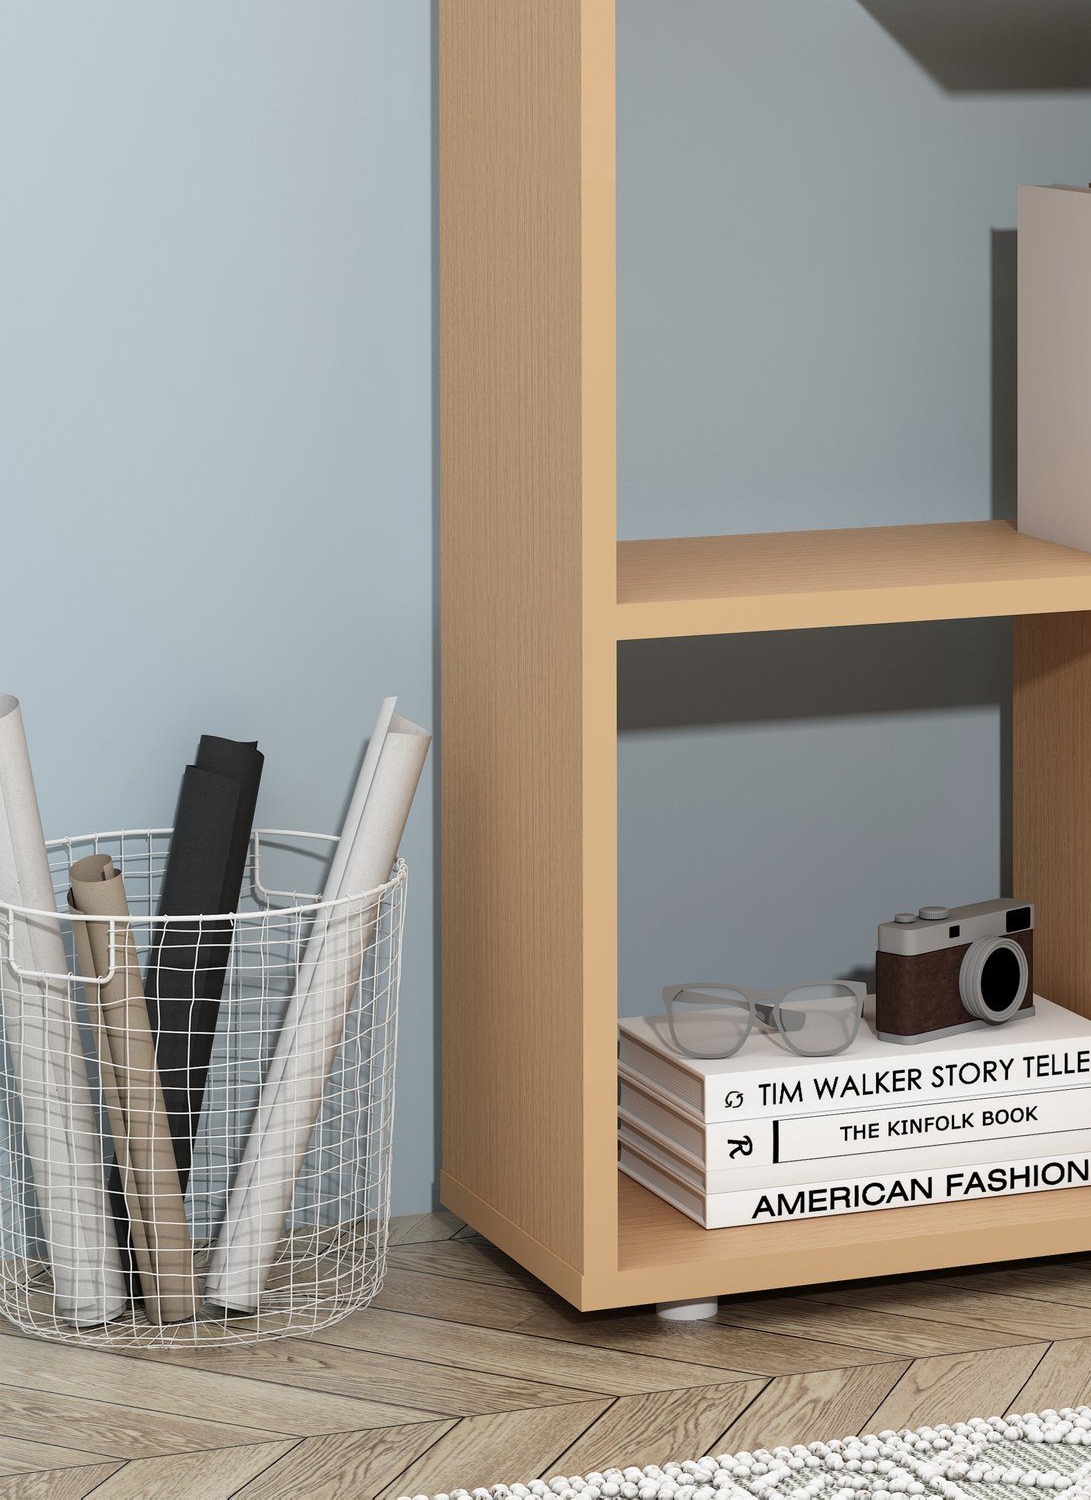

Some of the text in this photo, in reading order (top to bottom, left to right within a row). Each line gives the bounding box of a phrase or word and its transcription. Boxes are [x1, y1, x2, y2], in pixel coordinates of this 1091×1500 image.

[759, 1081, 803, 1105] TIM
[814, 1069, 921, 1100] WALKER
[931, 1059, 1014, 1087] STORY
[839, 1106, 1038, 1142] THE KINFOLK BOOK
[752, 1158, 1090, 1219] AMERICAN FASHION
